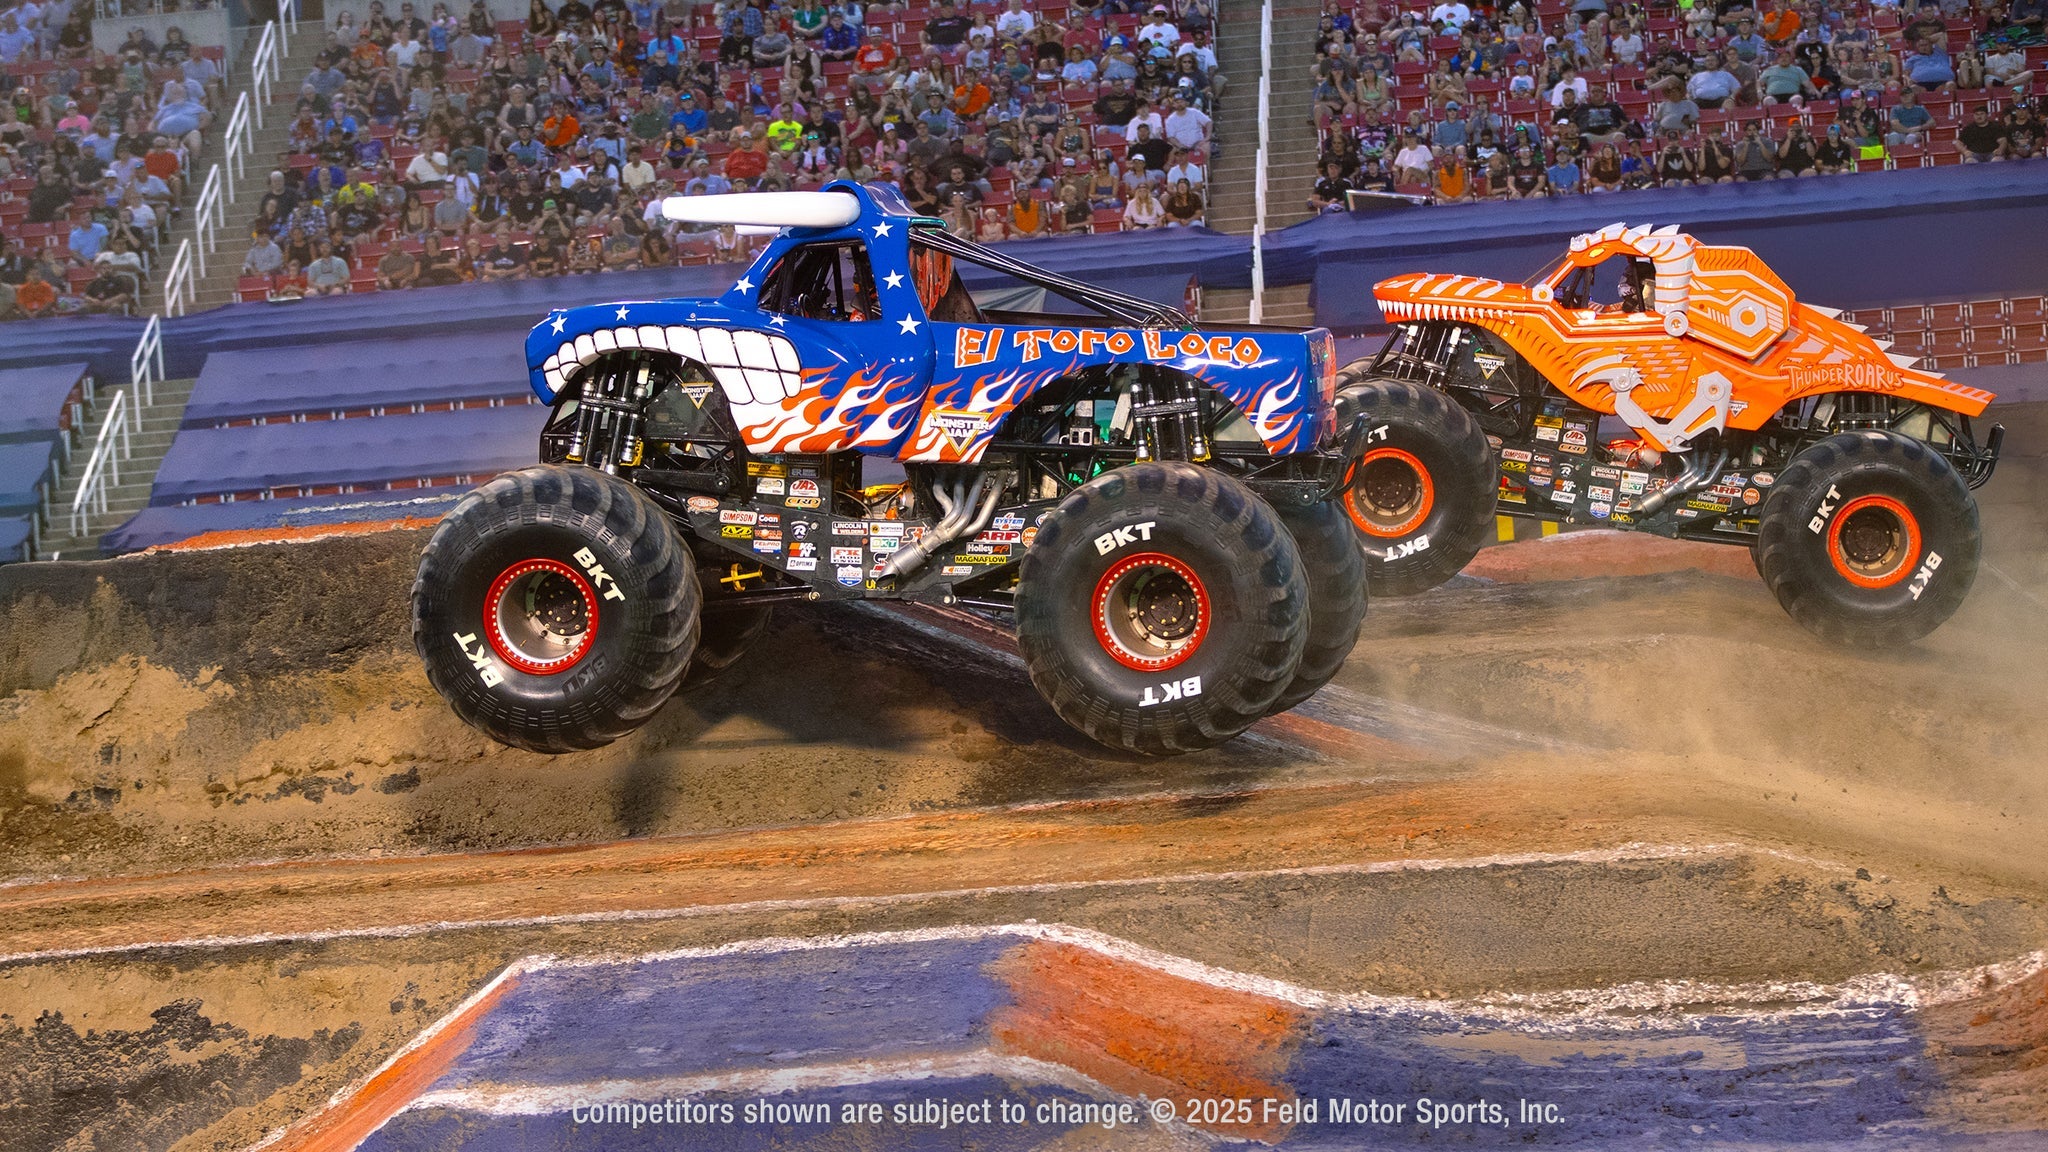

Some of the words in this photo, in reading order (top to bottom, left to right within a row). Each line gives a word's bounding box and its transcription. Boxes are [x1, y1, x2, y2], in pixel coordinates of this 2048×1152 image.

[954, 327, 1004, 369] El
[1473, 357, 1505, 366] MONSTER
[929, 417, 990, 431] MONSTER
[946, 427, 973, 438] JAM
[1566, 432, 1584, 440] JAZ
[1503, 451, 1529, 461] SIMPSON
[792, 480, 817, 490] JAZ
[1709, 485, 1741, 494] ARP
[1697, 493, 1718, 503] Holley
[1688, 501, 1727, 511] MAGNAFLOW
[1808, 484, 1842, 534] BKT
[722, 512, 754, 522] SIMPSON
[758, 514, 779, 522] Coan
[977, 532, 1020, 541] ARP
[1094, 521, 1156, 556] BKT
[872, 538, 898, 548] BKT
[1384, 534, 1430, 562] BKT
[967, 544, 994, 555] Holley
[955, 555, 1006, 564] MAGNAFLOW
[573, 546, 626, 601] BKT
[1907, 551, 1943, 600] BKT
[453, 631, 504, 689] BKT
[1139, 676, 1202, 706] BKT
